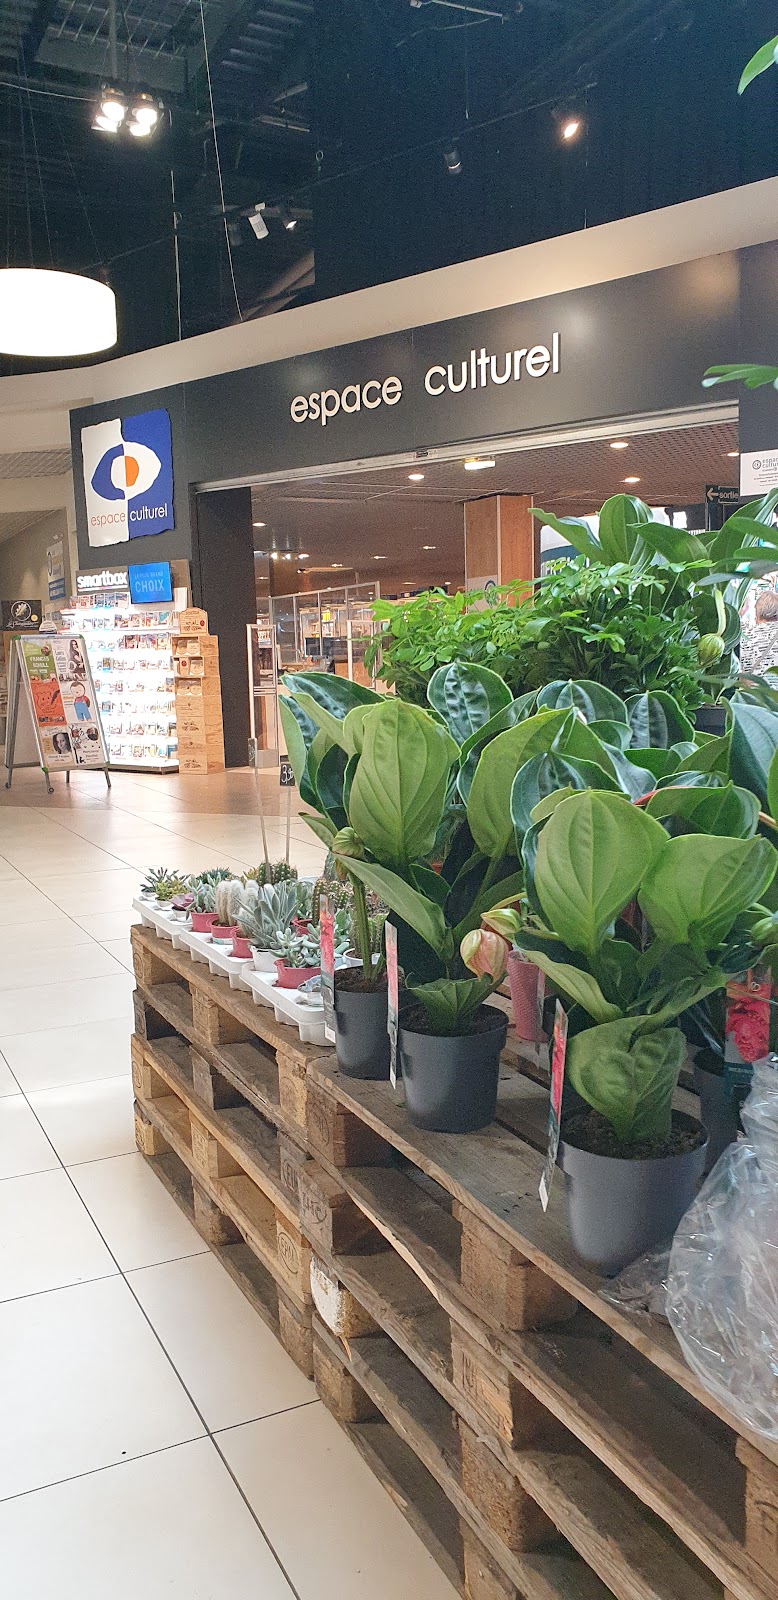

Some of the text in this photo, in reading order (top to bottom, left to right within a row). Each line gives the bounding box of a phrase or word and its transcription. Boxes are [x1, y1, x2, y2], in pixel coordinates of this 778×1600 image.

[290, 332, 561, 426] espace culturel
[719, 490, 739, 499] sortie
[90, 502, 168, 528] espace culturel
[77, 570, 128, 588] smartbox
[135, 578, 165, 593] CHOIX
